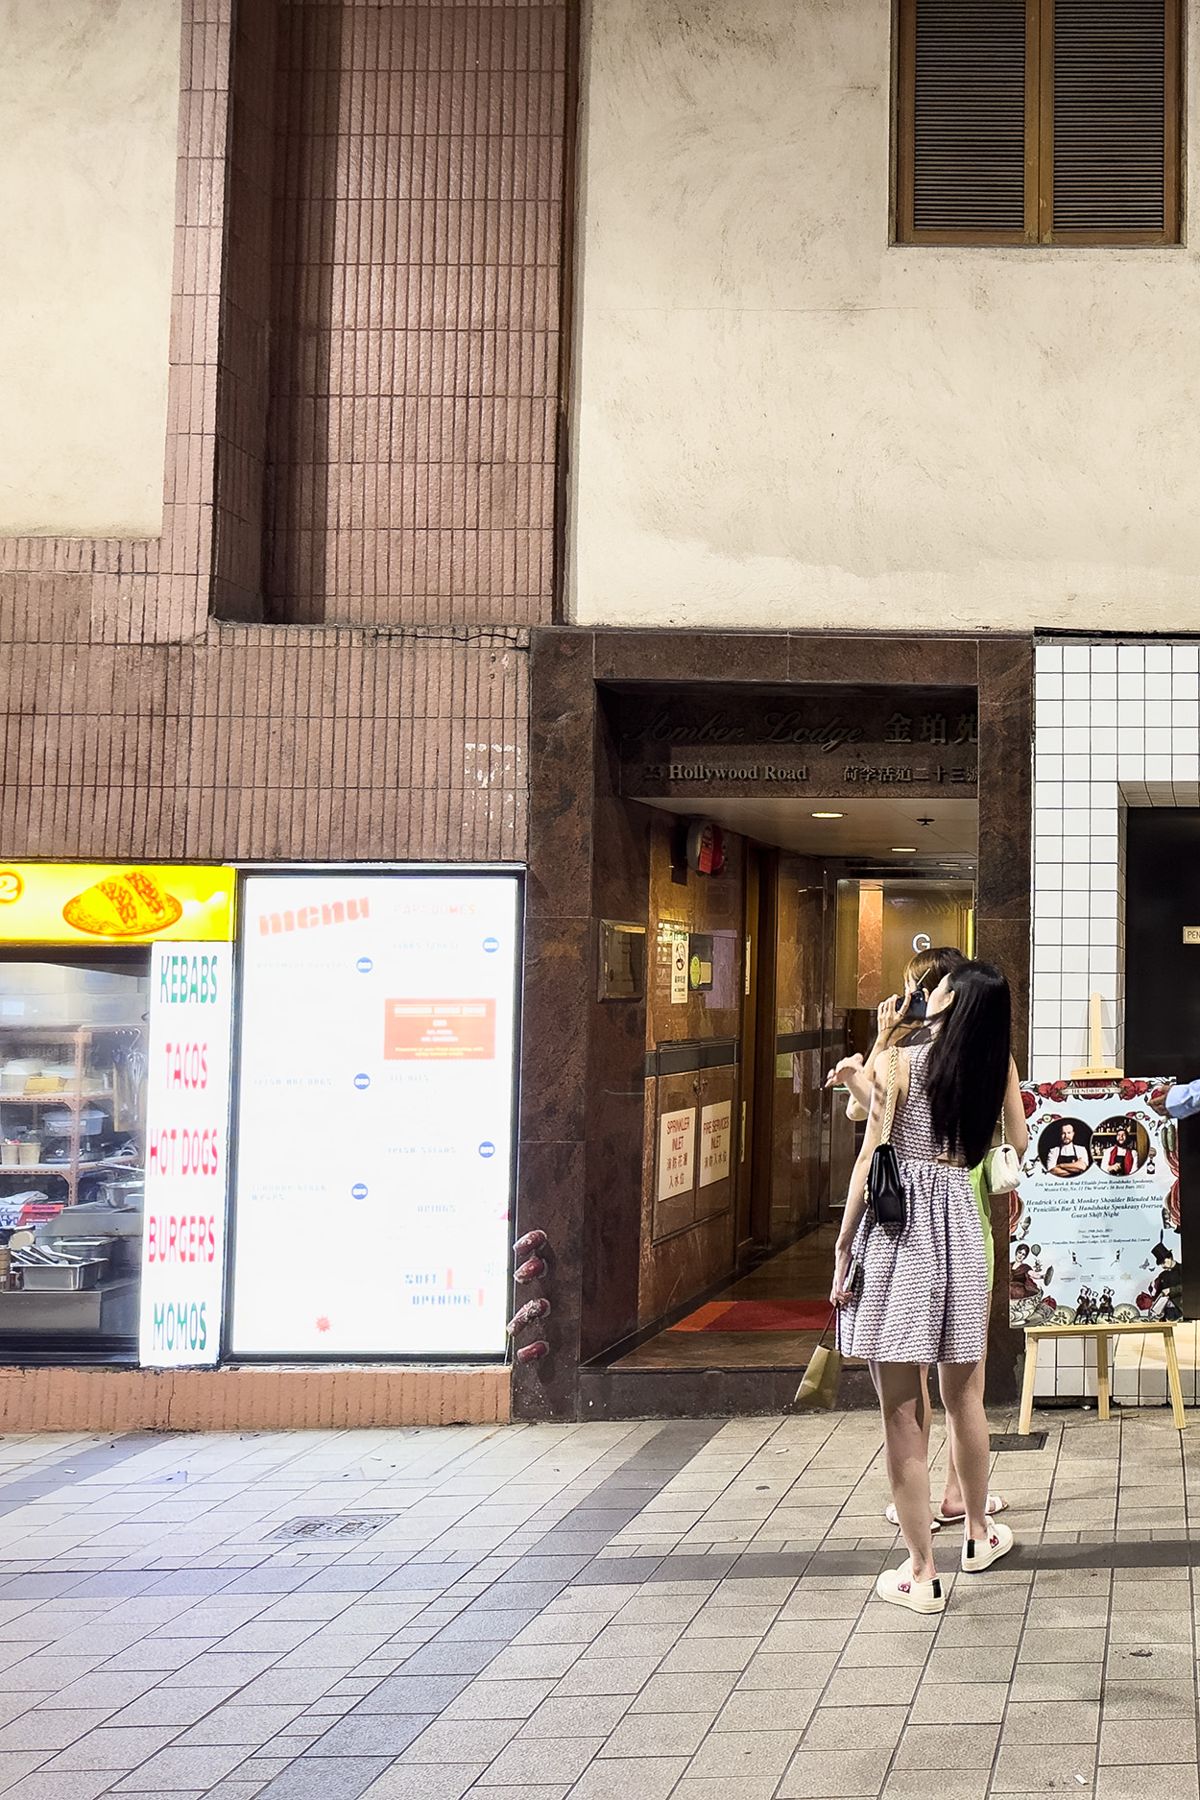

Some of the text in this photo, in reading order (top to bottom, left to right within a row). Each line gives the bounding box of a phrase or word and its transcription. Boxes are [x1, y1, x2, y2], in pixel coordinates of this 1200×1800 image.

[755, 711, 865, 752] Lodge
[669, 764, 759, 783] Hollywood
[764, 764, 808, 781] Road
[259, 896, 370, 937] menu
[912, 933, 931, 953] G
[160, 955, 218, 1004] KEBABS
[165, 1043, 208, 1090] TACOS
[666, 1116, 690, 1135] SPRINKLER
[149, 1129, 218, 1175] HOT DOGS
[672, 1135, 684, 1151] INLET
[710, 1135, 722, 1150] INLET
[1077, 1197, 1100, 1205] Monkey
[1126, 1195, 1149, 1203] Blended
[1078, 1204, 1110, 1212] Handshake
[1111, 1203, 1140, 1212] Speakeasy
[1102, 1211, 1120, 1219] Night
[149, 1215, 215, 1263] BURGERS
[153, 1302, 207, 1351] MOMOS
